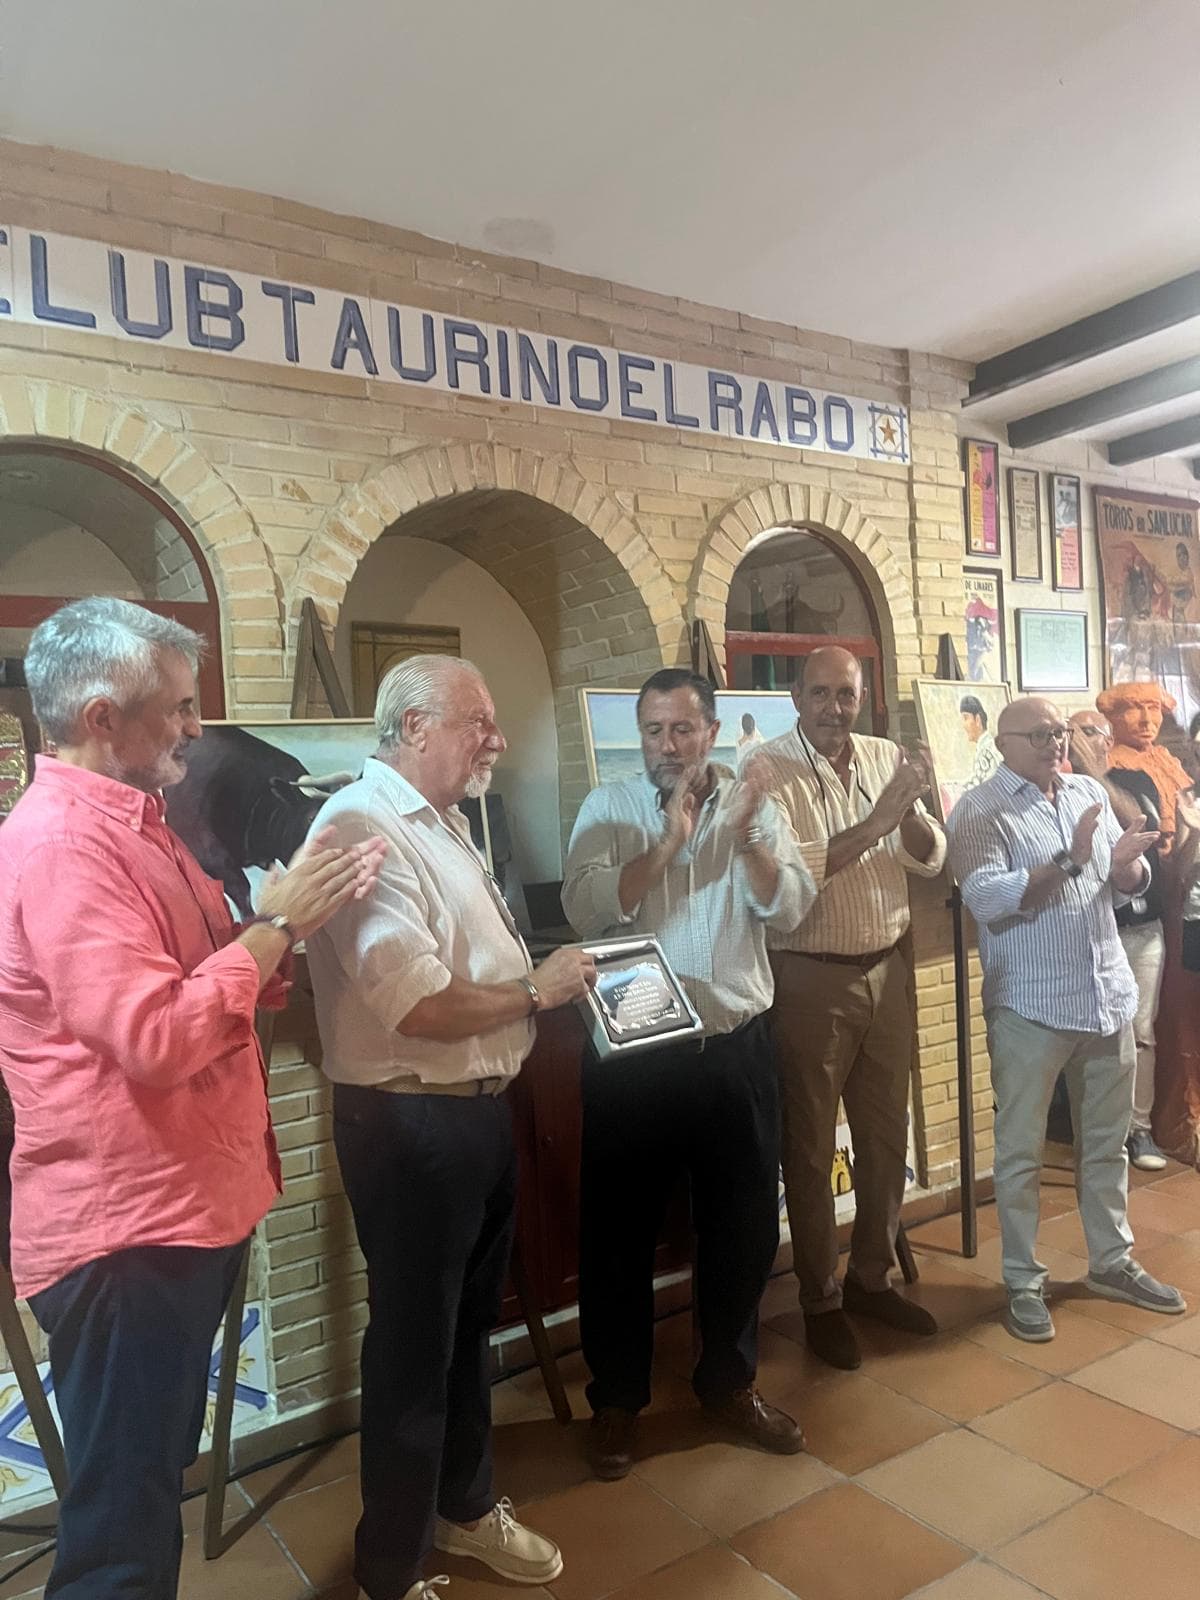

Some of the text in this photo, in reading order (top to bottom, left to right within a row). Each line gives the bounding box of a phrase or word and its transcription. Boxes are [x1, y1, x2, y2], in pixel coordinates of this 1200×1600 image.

[0, 228, 854, 452] LUB TAURINO EL RABO
[1103, 503, 1134, 531] TOROS
[1147, 509, 1193, 538] SANLUCAR
[965, 580, 994, 592] DE LINARES
